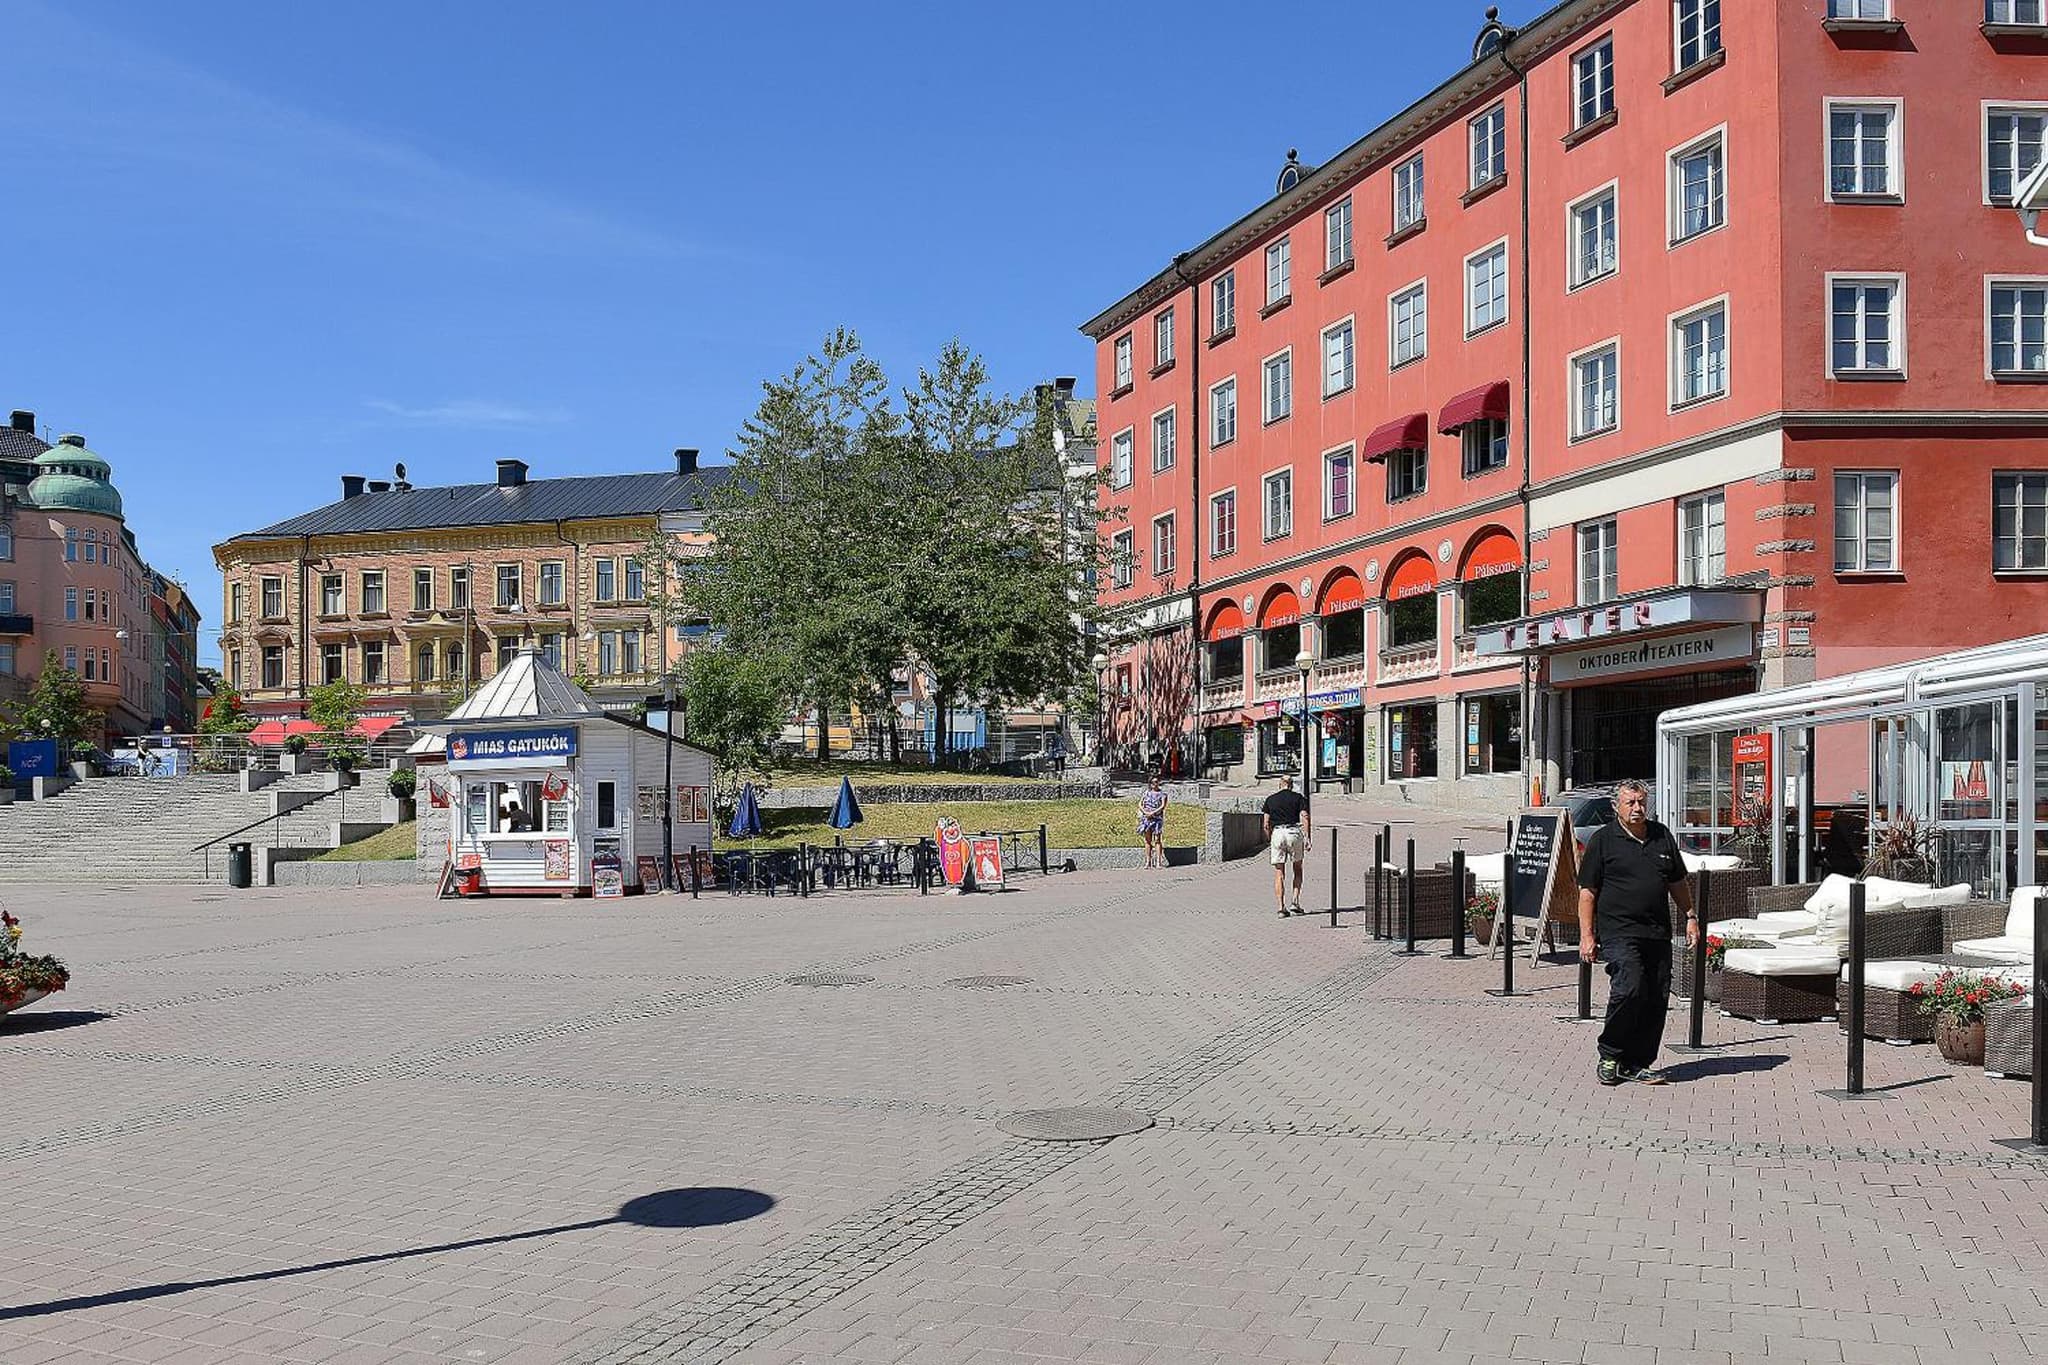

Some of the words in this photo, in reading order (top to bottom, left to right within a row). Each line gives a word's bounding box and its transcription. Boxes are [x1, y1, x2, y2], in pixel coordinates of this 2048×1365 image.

[1502, 602, 1651, 650] TEATER
[473, 739, 504, 754] MIAS
[508, 734, 568, 753] GATUKÖK
